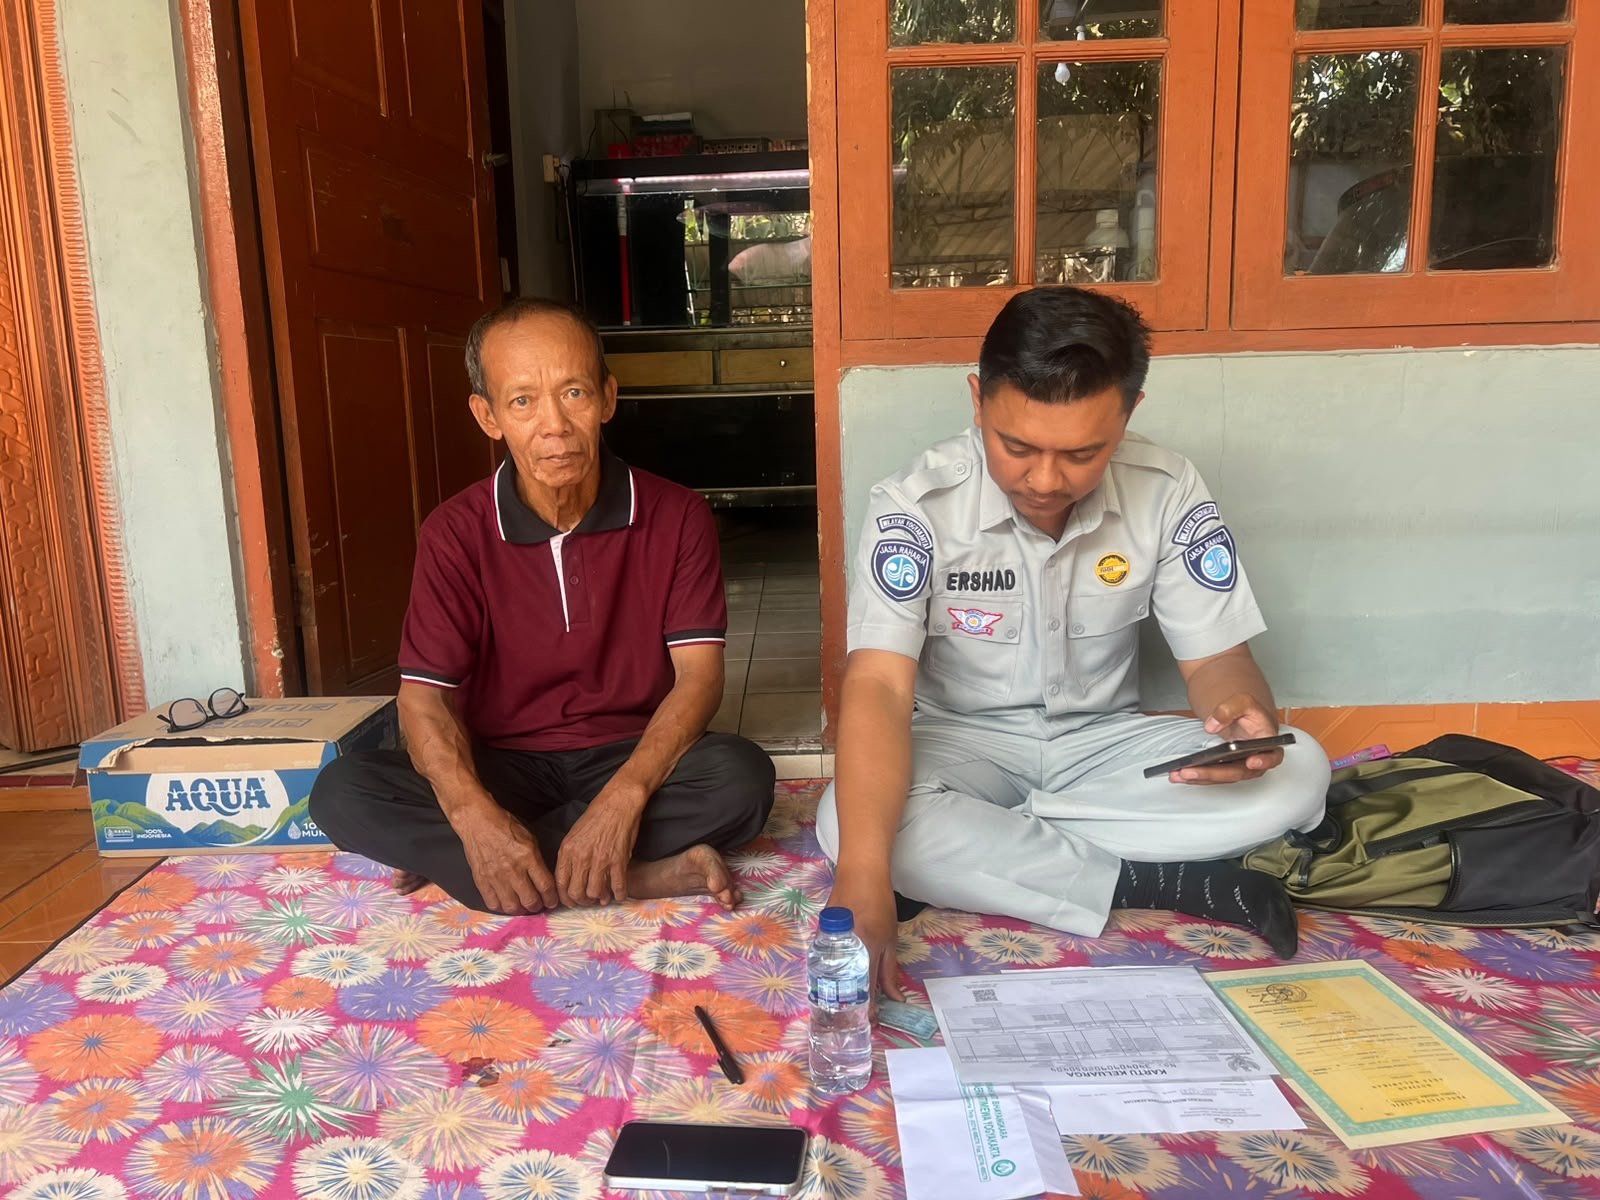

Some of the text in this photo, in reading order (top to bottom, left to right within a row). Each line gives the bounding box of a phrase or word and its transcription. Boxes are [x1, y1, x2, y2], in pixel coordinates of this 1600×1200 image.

[881, 517, 930, 550] WILAYAH YOGYAKARTA
[879, 545, 927, 567] JASA RAHARJA
[1189, 546, 1205, 561] JASA
[946, 569, 1016, 592] ERSHAD
[165, 777, 271, 816] AQUA
[302, 830, 327, 838] MUR
[1065, 1069, 1167, 1078] KARTU KELUARGA
[983, 1120, 1001, 1159] YOGYAKARTA
